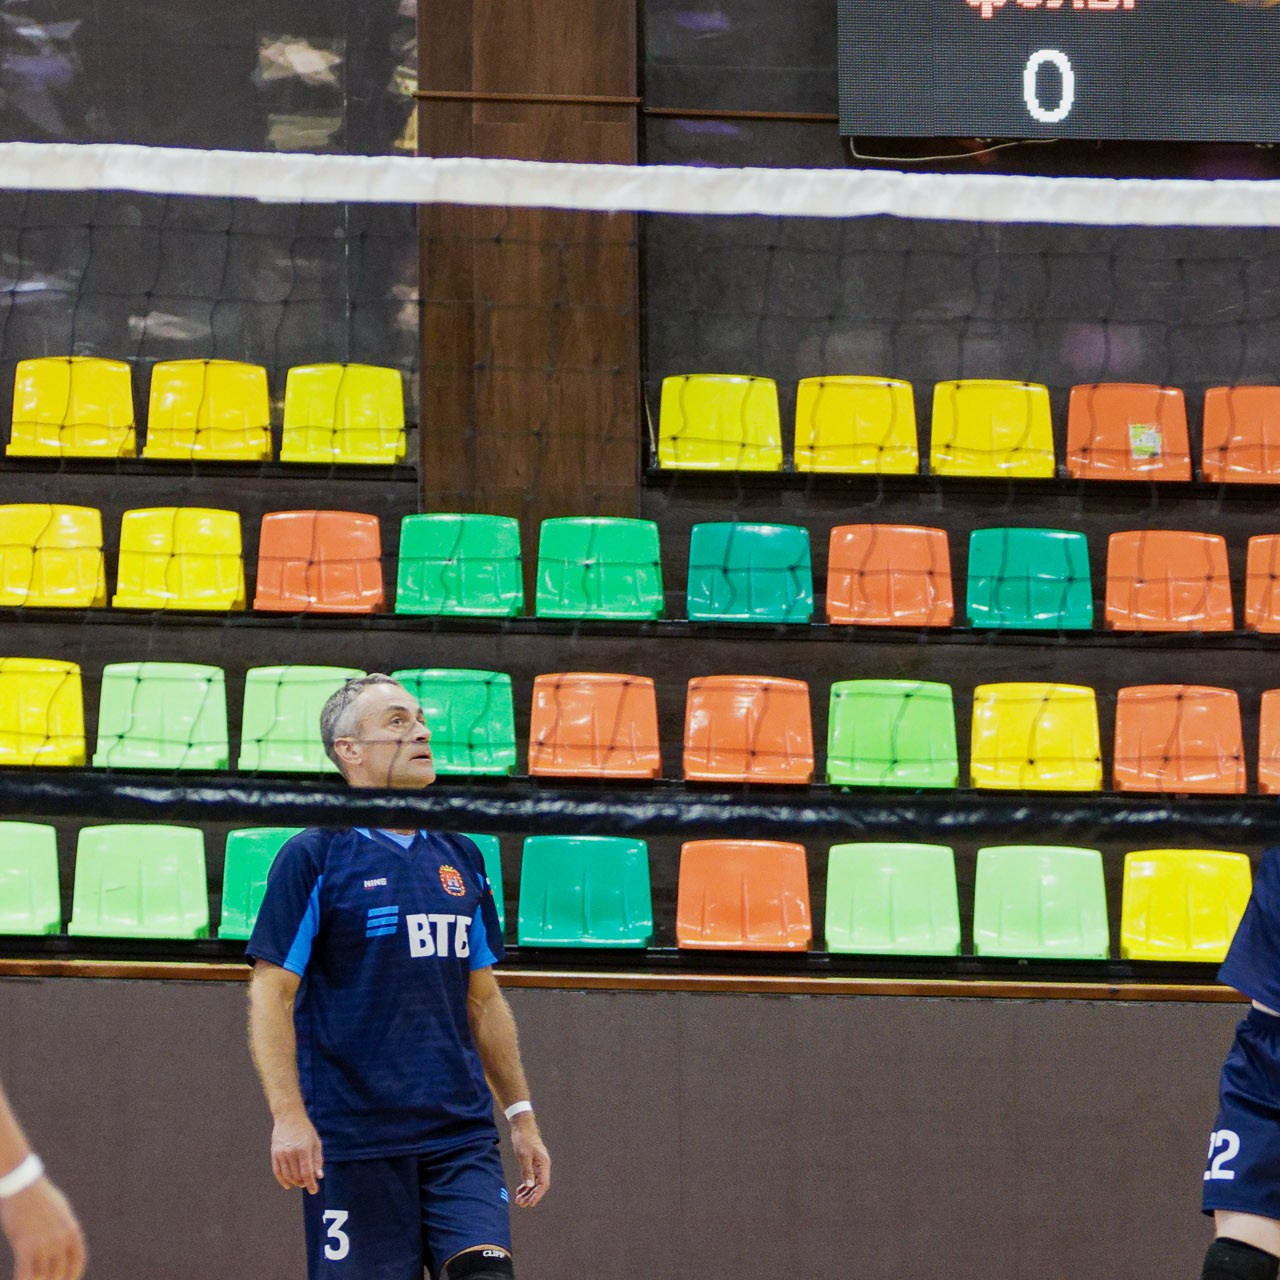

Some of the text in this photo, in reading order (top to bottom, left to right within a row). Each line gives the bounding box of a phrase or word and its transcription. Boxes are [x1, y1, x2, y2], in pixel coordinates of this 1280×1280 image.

[1021, 48, 1076, 125] 0
[406, 913, 472, 958] ВТБ
[322, 1209, 350, 1261] 3
